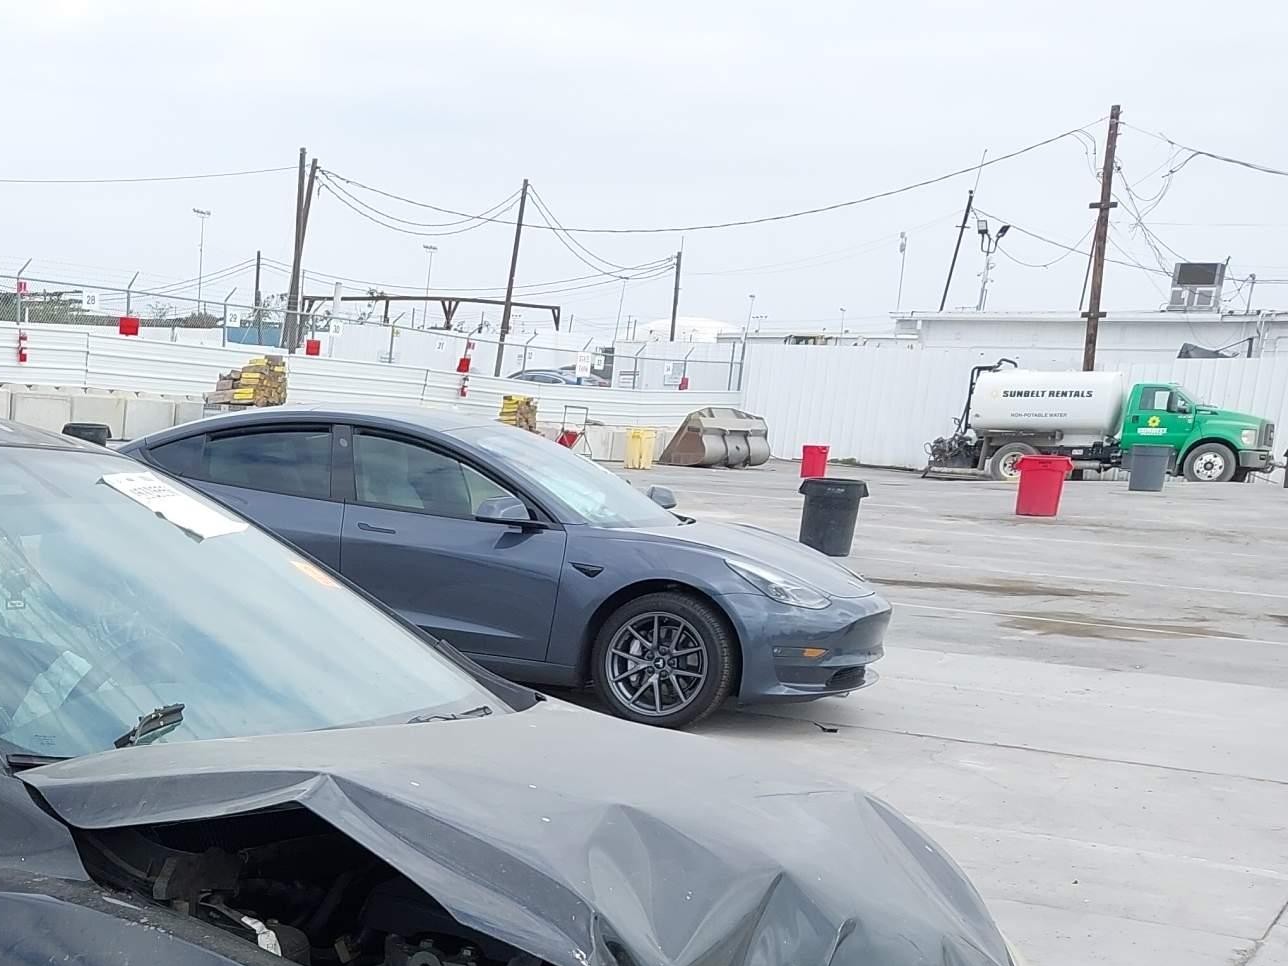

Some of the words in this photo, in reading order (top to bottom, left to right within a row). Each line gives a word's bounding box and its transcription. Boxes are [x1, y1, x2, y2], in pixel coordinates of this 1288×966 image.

[86, 295, 96, 305] 28
[1002, 390, 1046, 398] SUNBELT
[1048, 390, 1093, 398] RENTALS
